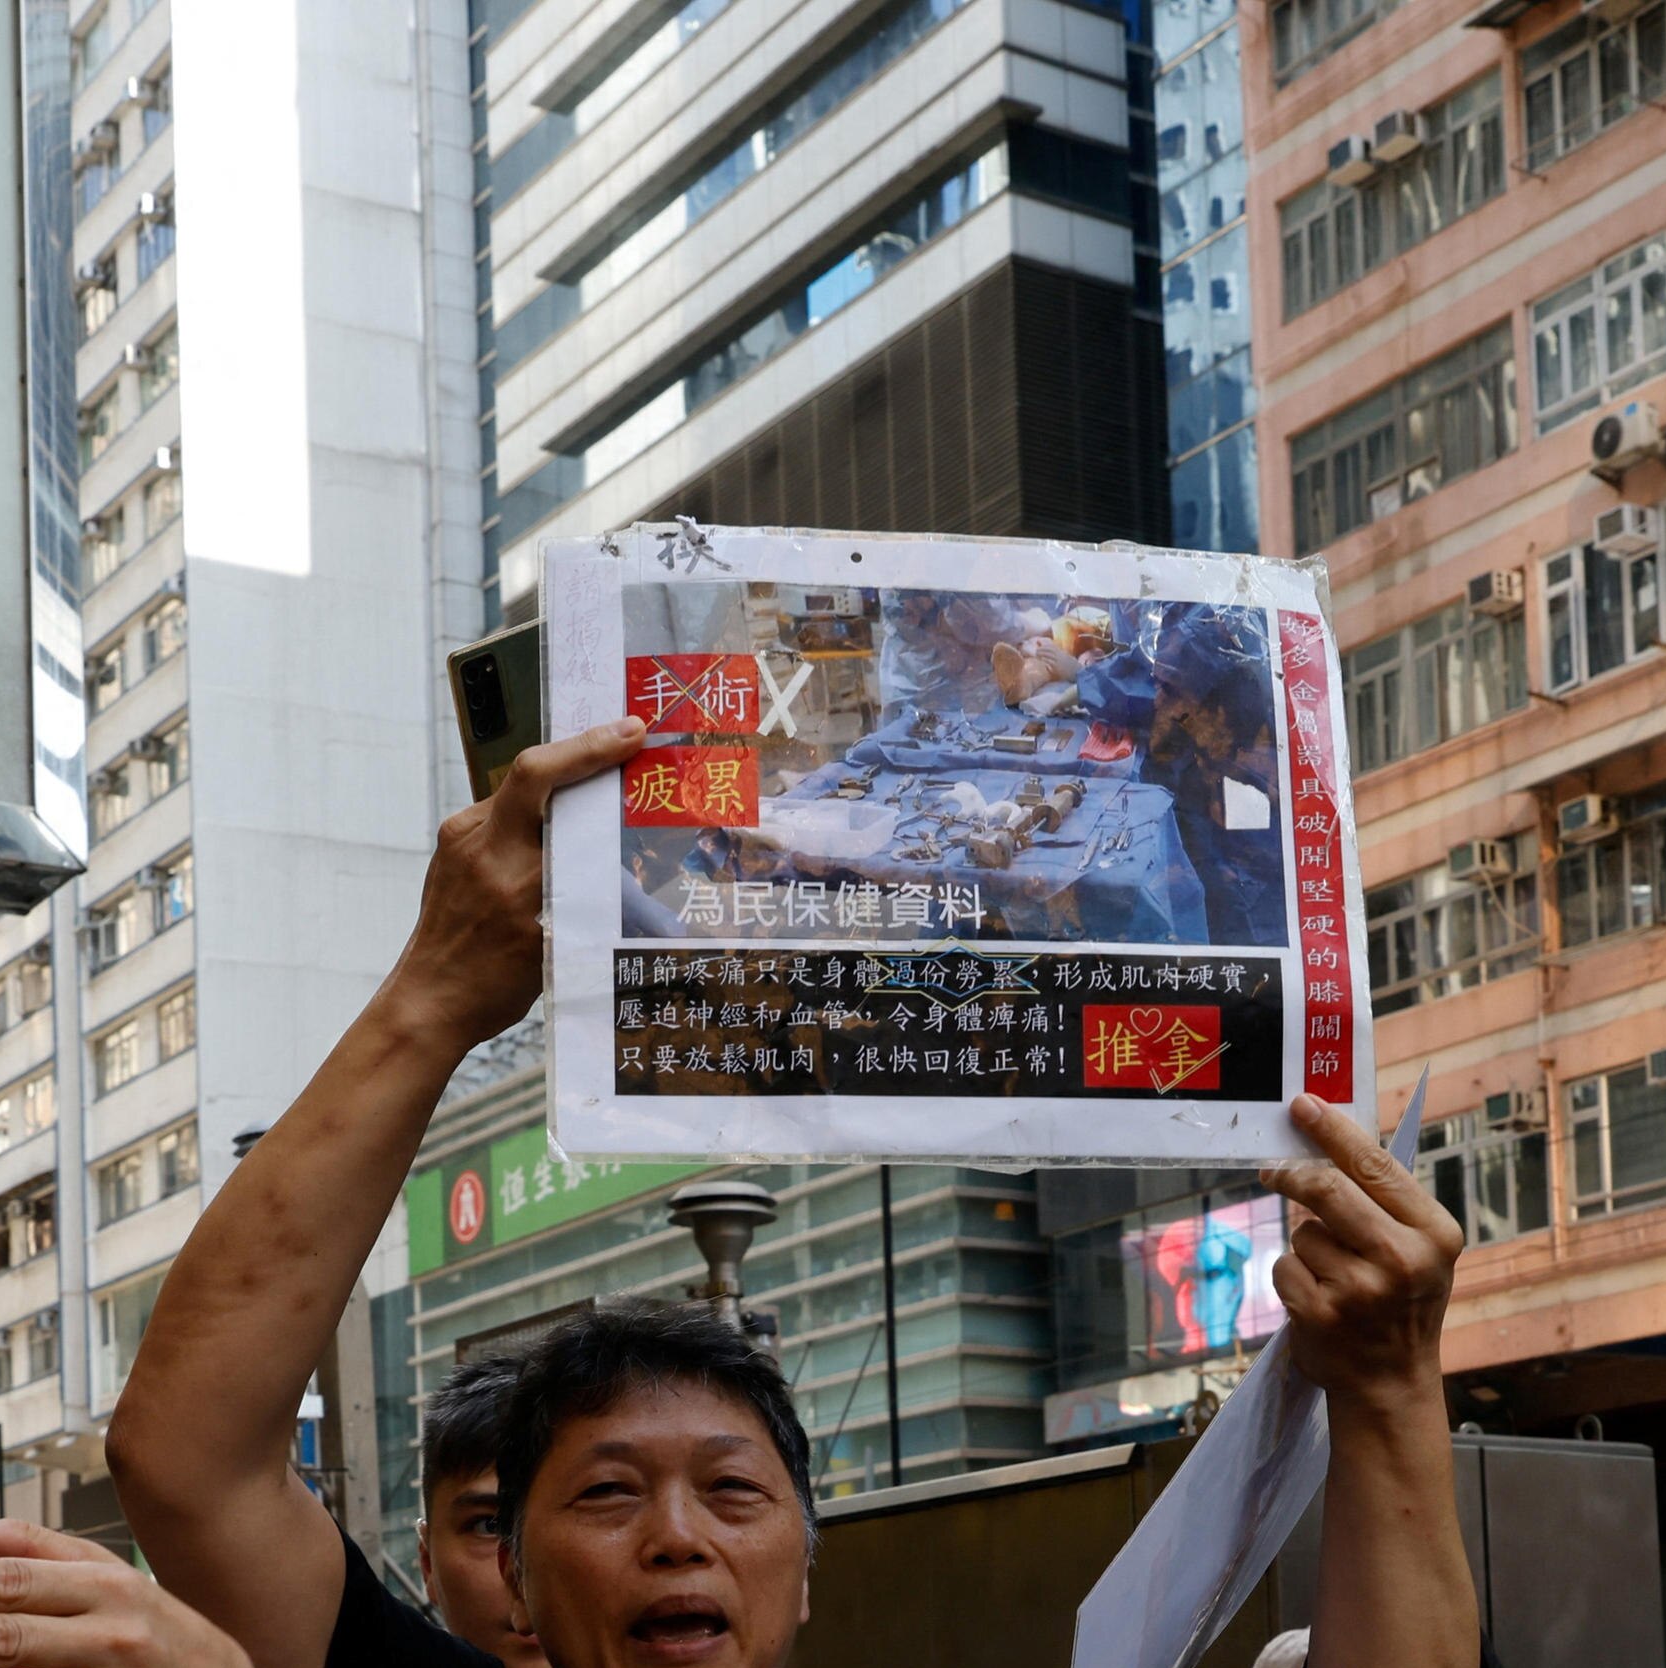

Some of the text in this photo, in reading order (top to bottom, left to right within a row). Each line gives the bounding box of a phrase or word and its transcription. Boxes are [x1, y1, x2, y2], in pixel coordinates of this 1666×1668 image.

[634, 669, 754, 722] 手術
[629, 759, 745, 815] 疲累
[676, 879, 988, 930] 為民保健資料
[1086, 1016, 1210, 1080] 推拿
